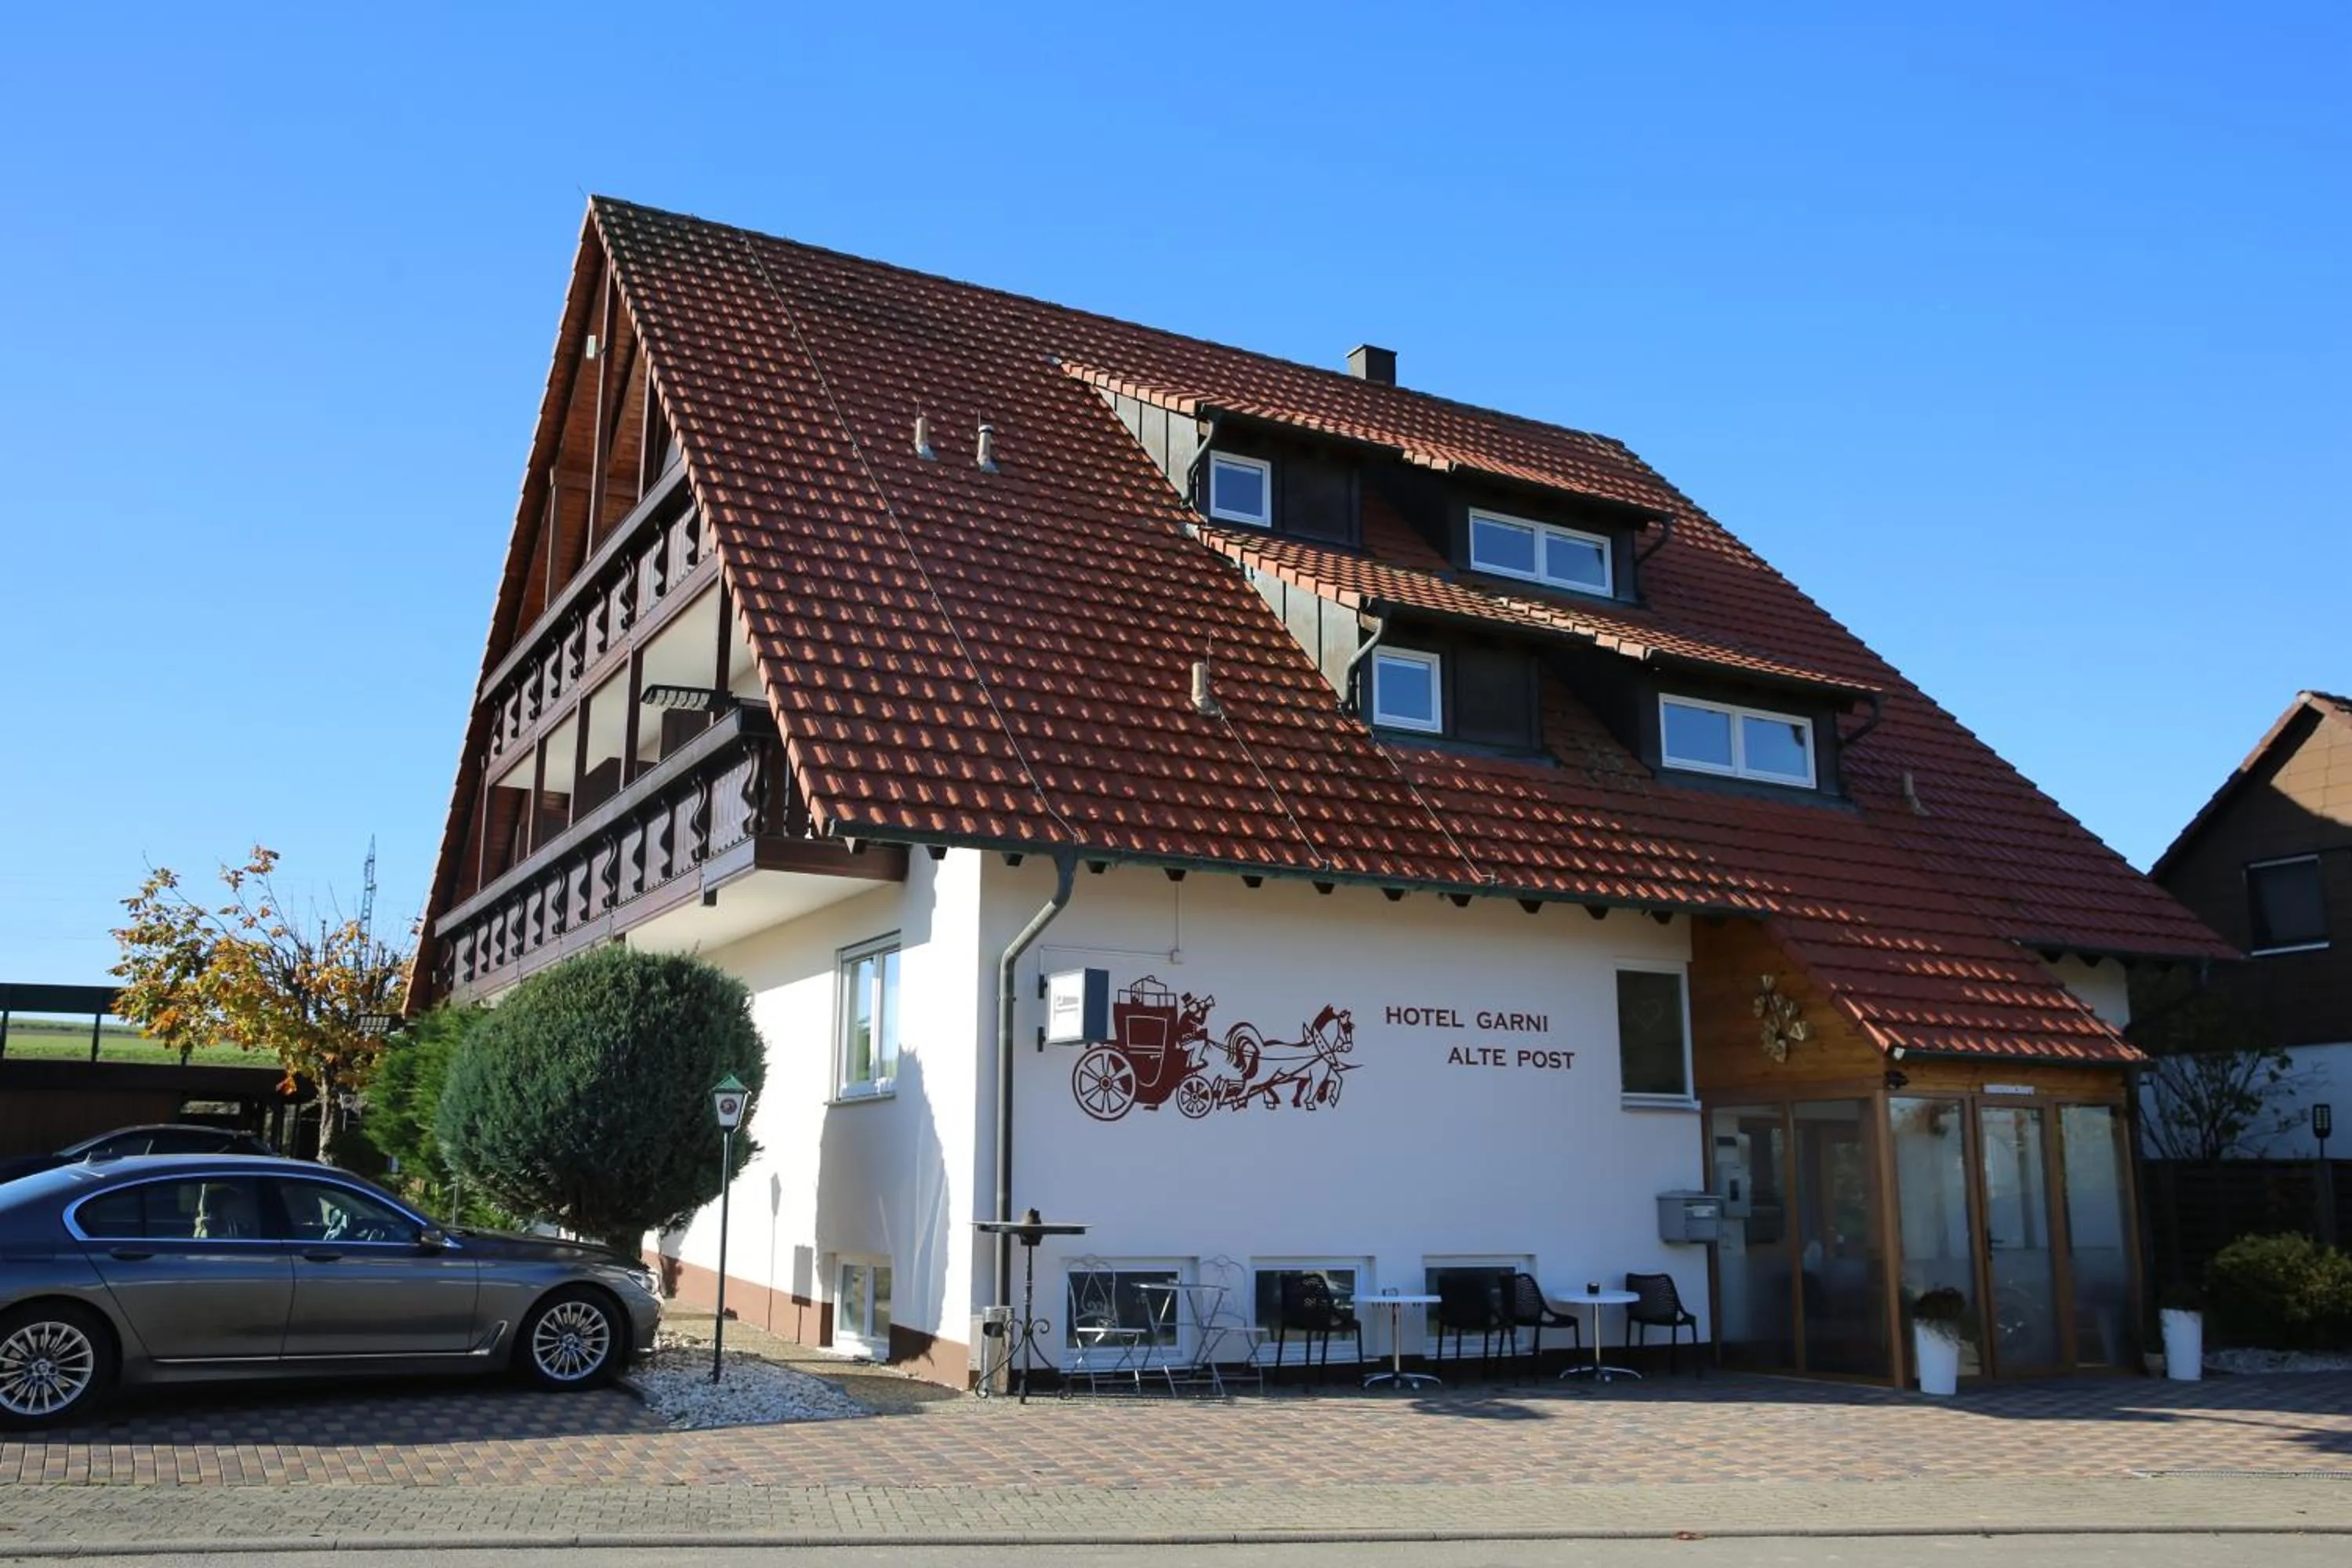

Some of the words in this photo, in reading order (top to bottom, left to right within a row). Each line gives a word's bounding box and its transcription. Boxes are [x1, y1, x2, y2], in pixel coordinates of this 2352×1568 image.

[1385, 1006, 1465, 1028] HOTEL
[1476, 1011, 1548, 1033] GARNI
[1448, 1047, 1507, 1067] ALTE
[1517, 1050, 1575, 1069] POST
